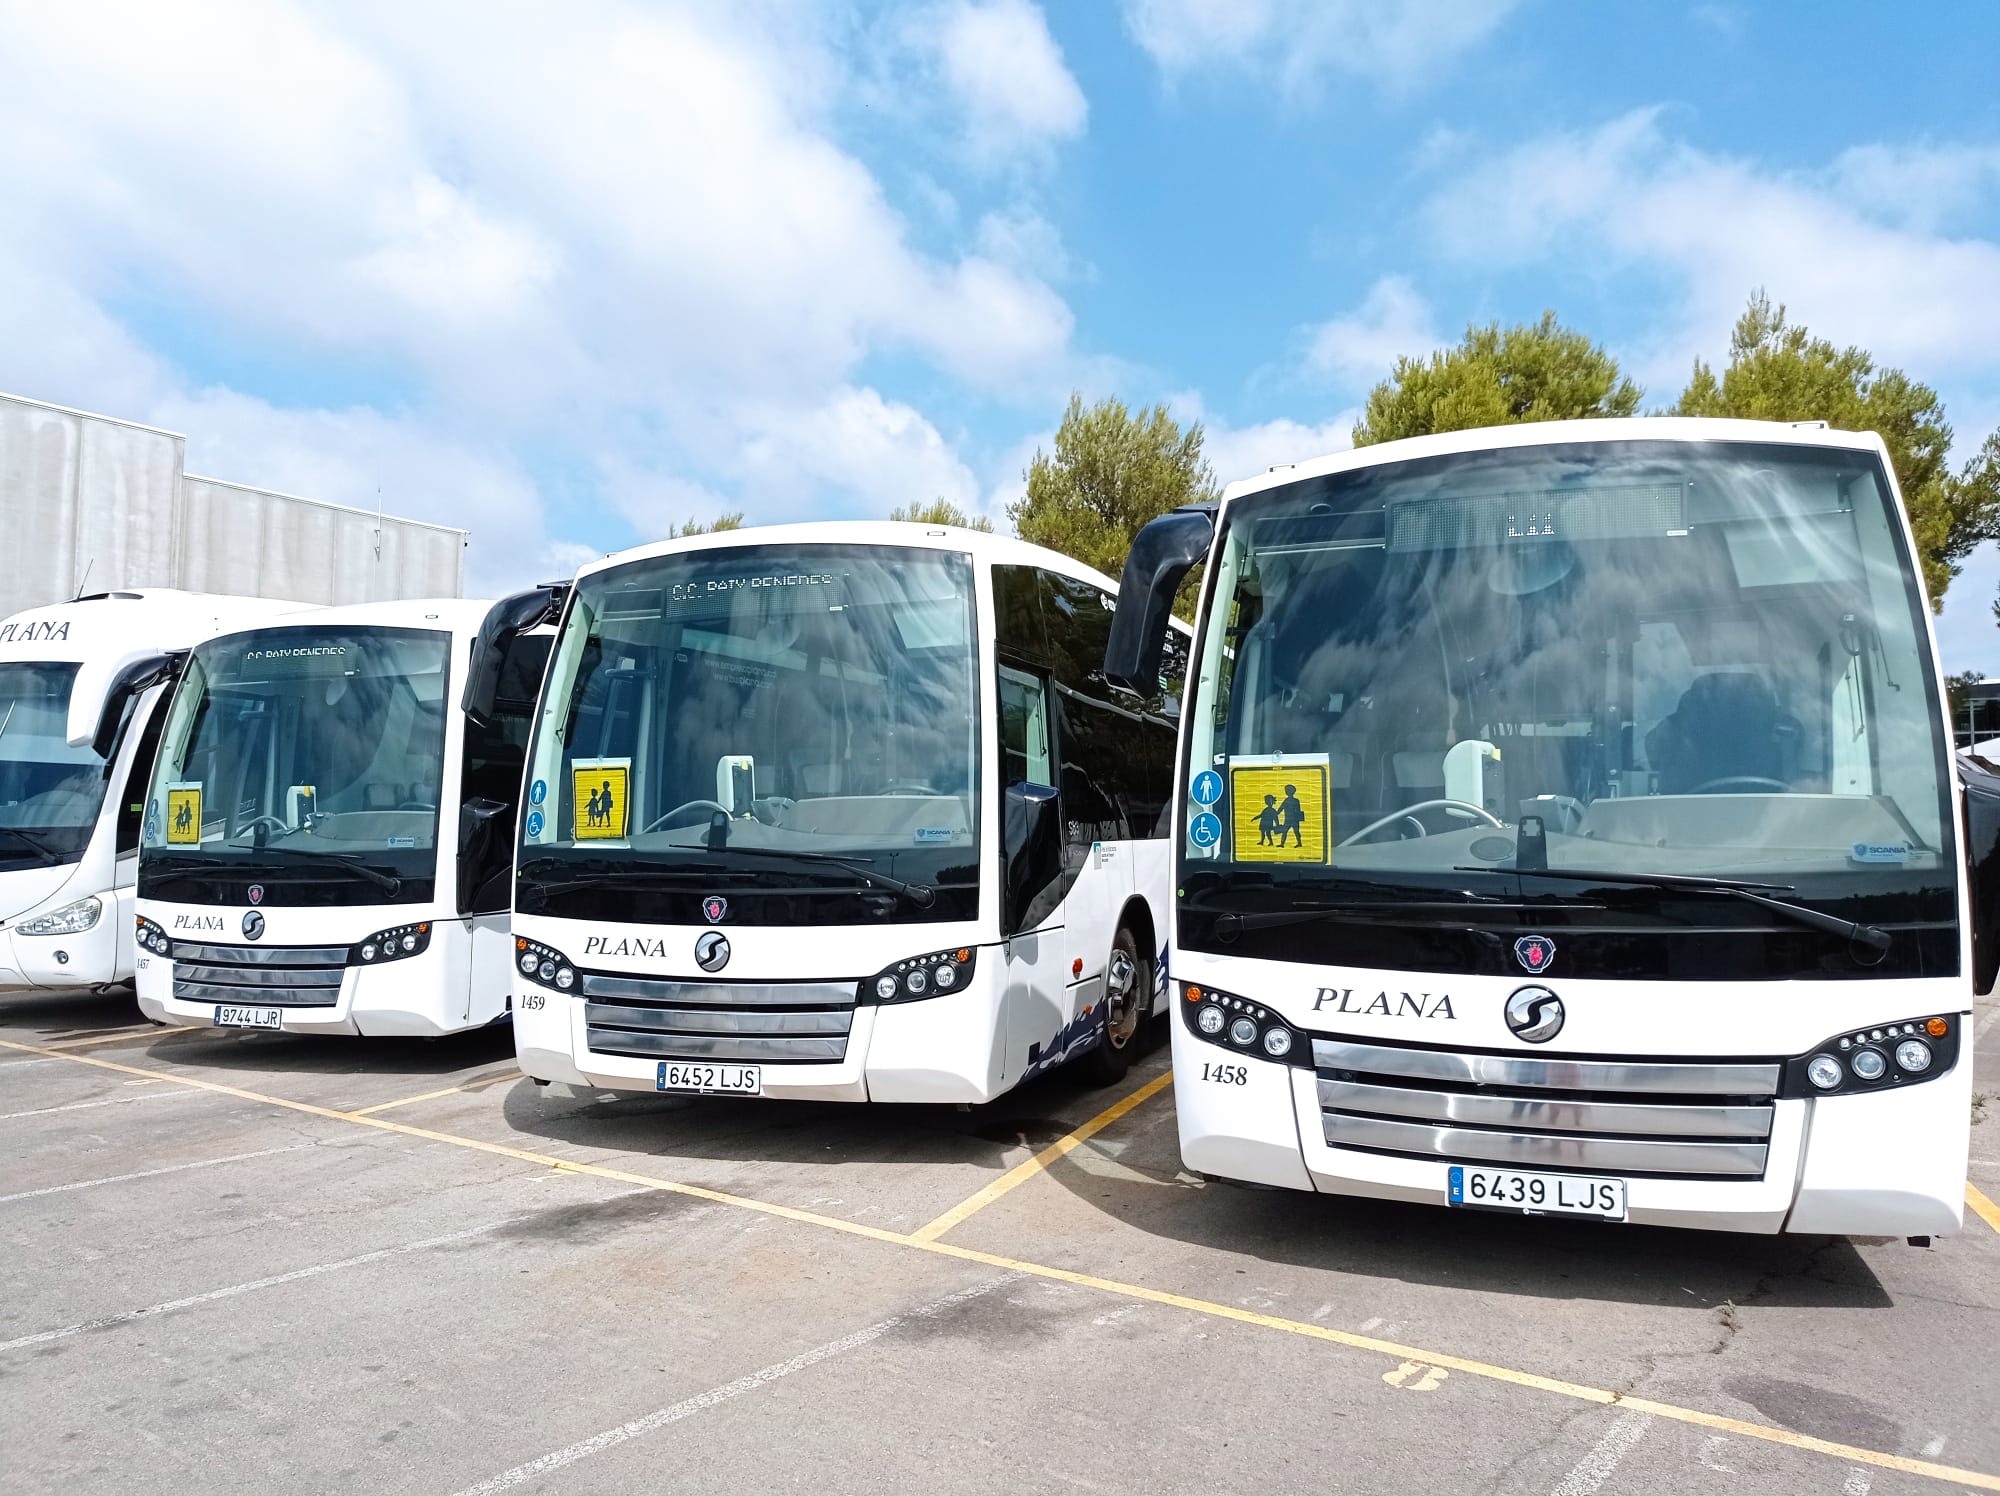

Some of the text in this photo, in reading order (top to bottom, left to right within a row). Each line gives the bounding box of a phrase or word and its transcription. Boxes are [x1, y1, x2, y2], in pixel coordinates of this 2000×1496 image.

[0, 621, 71, 642] PLANA
[1869, 846, 1906, 854] SCANIA
[174, 915, 225, 931] PLANA
[584, 936, 667, 958] PLANA
[136, 958, 150, 970] 1457
[521, 994, 546, 1010] 1459
[1311, 987, 1458, 1020] PLANA
[222, 1009, 251, 1024] 9744
[254, 1010, 278, 1025] LJR
[669, 1067, 714, 1087] 6452
[721, 1068, 754, 1088] LJS
[1201, 1062, 1248, 1086] 1458
[1470, 1173, 1546, 1204] 6439
[1558, 1181, 1616, 1211] LJS
